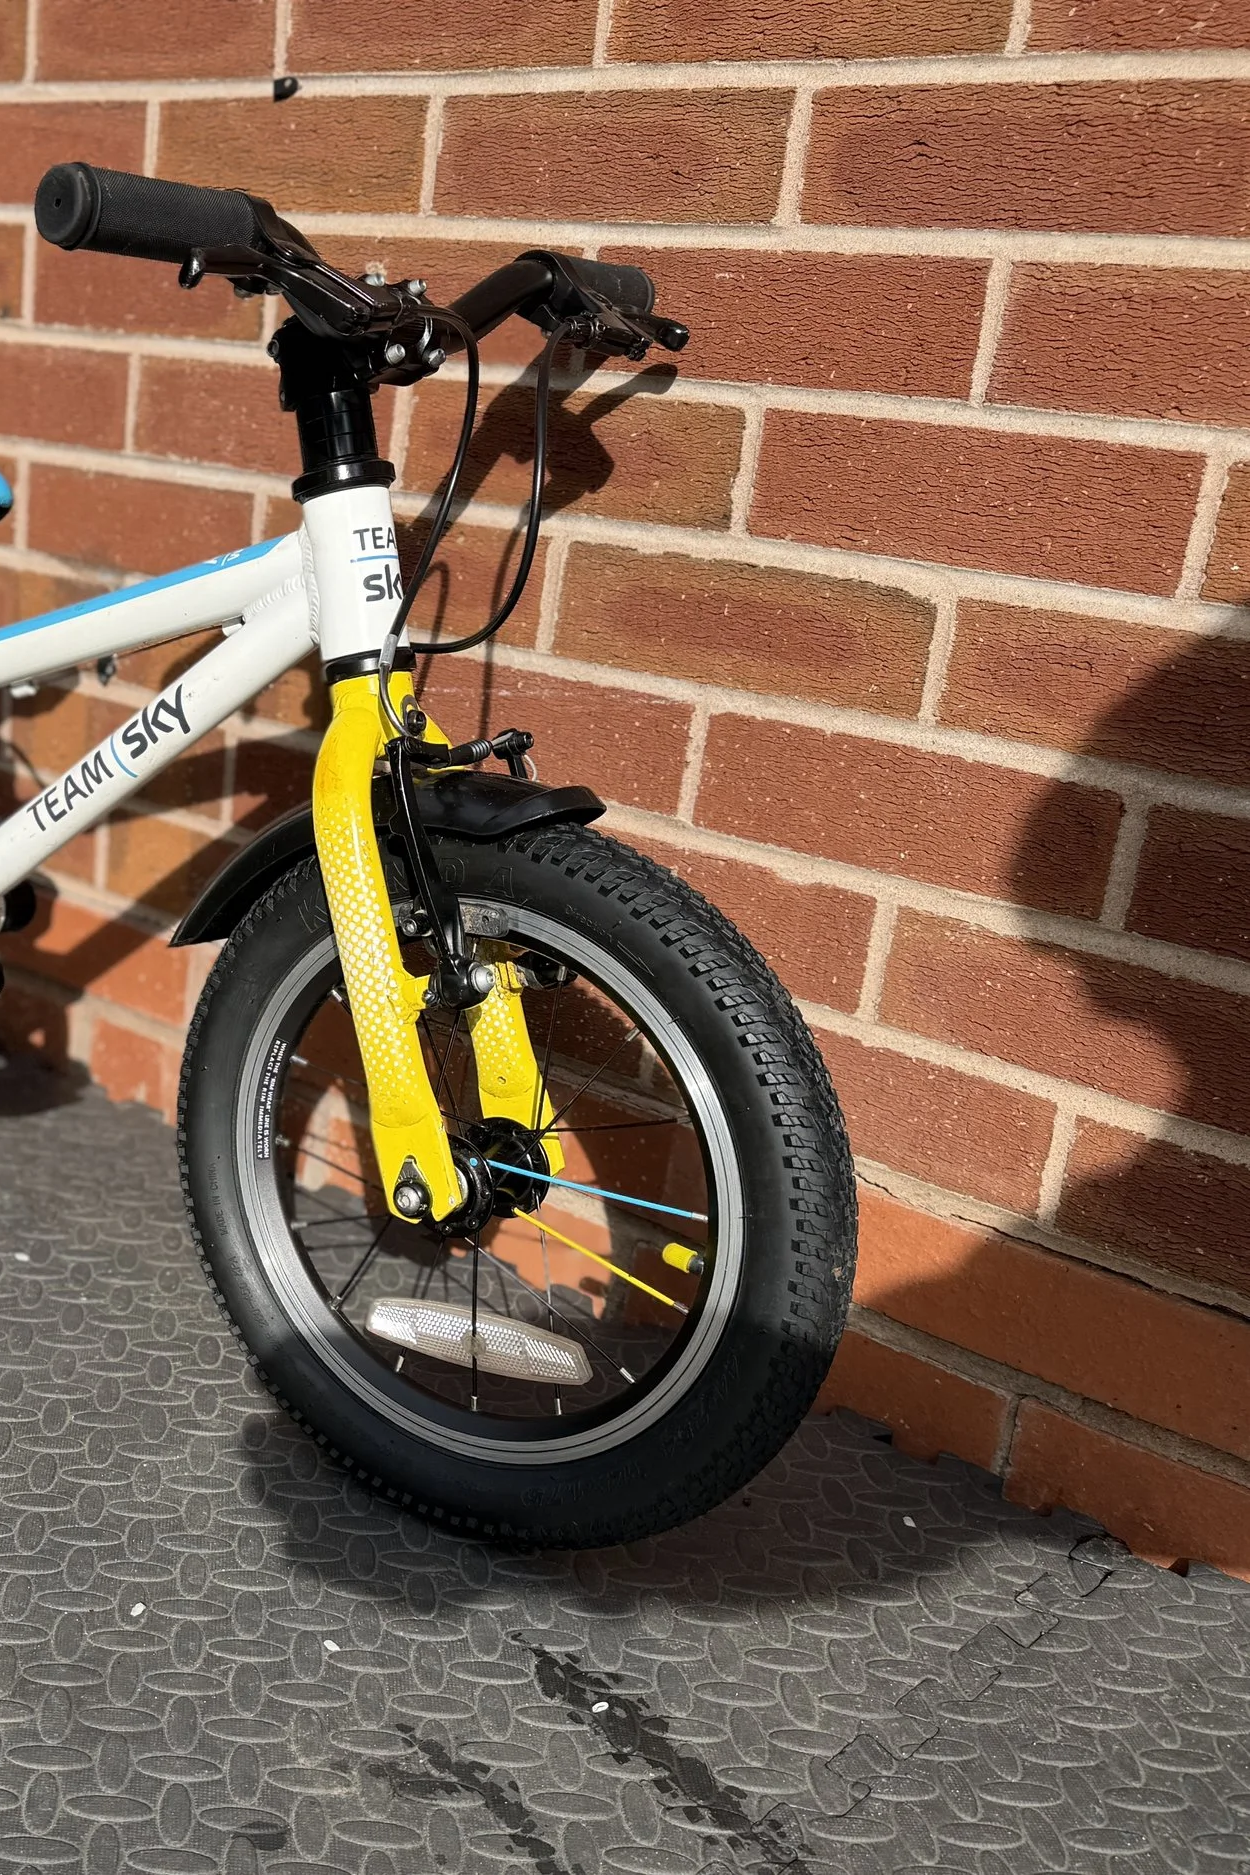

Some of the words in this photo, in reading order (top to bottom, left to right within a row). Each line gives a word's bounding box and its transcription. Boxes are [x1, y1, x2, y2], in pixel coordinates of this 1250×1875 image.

[26, 750, 115, 832] TEAM
[267, 1040, 280, 1070] REPLACE
[276, 1042, 287, 1061] WHEN
[263, 1072, 271, 1085] THE
[272, 1062, 280, 1073] THE
[260, 1087, 268, 1102] RIM
[257, 1105, 265, 1158] IMMEDIATELY
[207, 1162, 219, 1191] CHINA
[212, 1195, 221, 1206] IN
[215, 1209, 228, 1236] MADE
